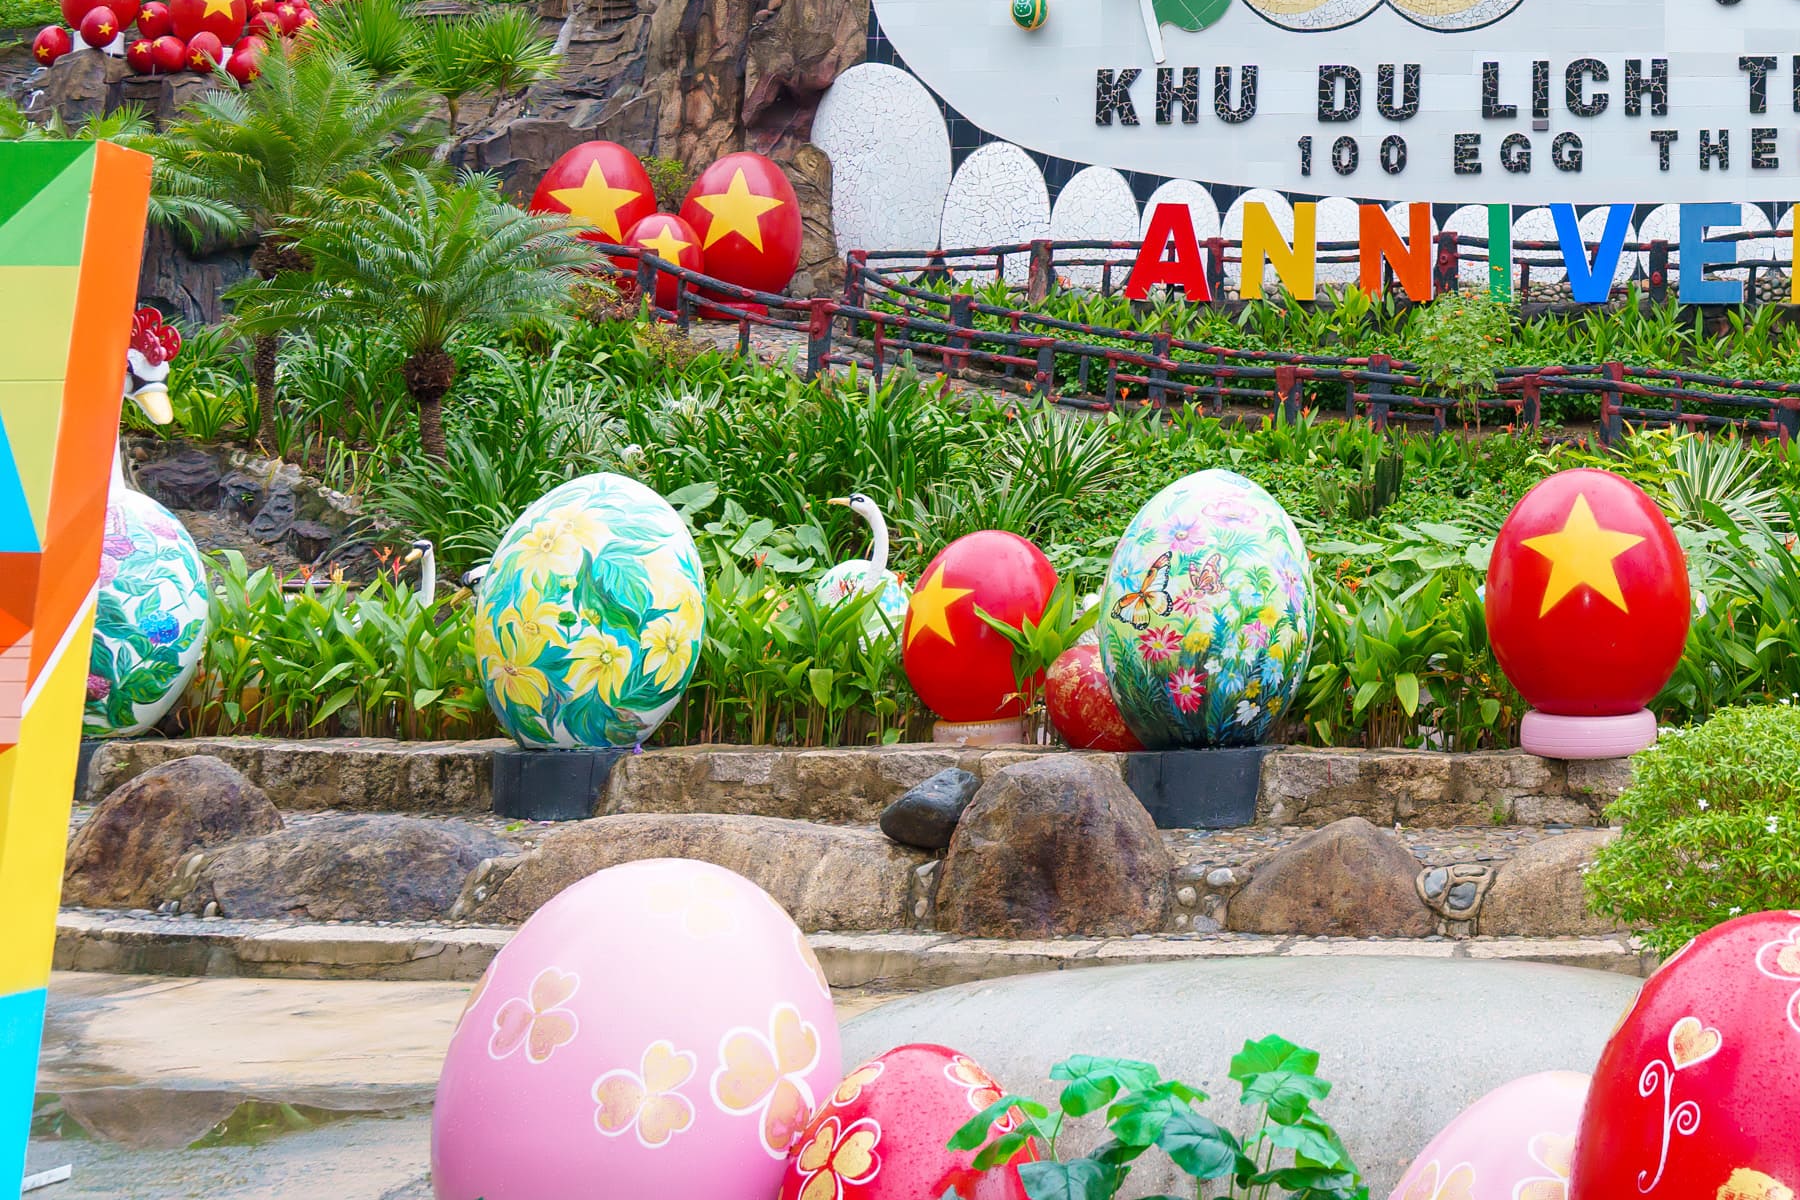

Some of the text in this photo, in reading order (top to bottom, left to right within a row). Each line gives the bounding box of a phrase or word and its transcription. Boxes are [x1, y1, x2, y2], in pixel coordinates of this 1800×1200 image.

[1095, 65, 1258, 126] KHU
[1317, 63, 1422, 122] DU
[1482, 57, 1669, 132] LỊCH
[1297, 134, 1409, 176] 100
[1454, 131, 1584, 175] EGG
